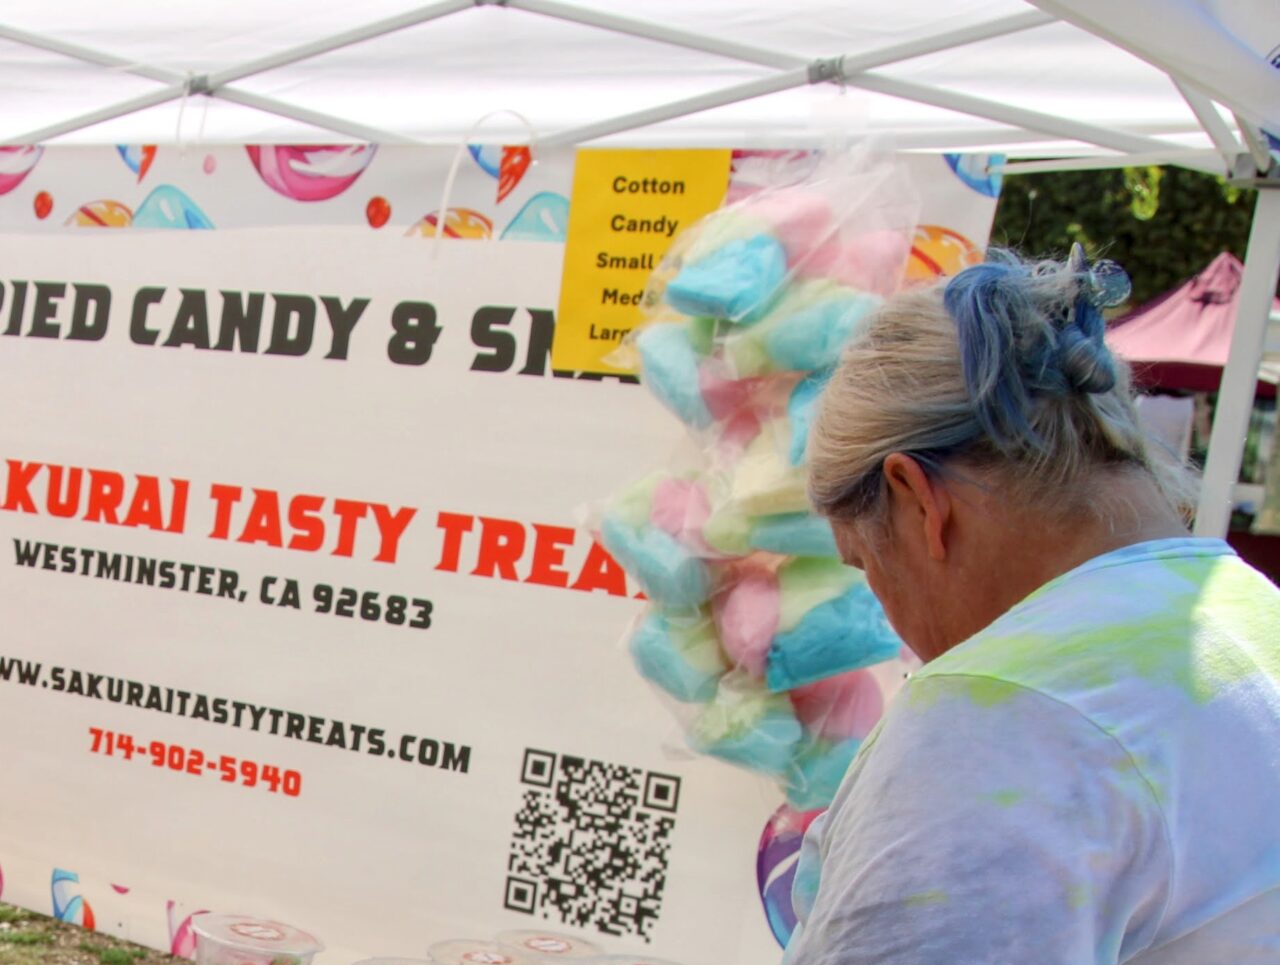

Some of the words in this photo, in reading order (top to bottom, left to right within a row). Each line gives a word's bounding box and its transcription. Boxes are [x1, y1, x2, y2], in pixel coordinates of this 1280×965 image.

[612, 176, 685, 194] Cotton
[610, 214, 678, 237] Candy
[596, 252, 653, 270] Small
[128, 285, 372, 361] CANDY
[386, 300, 444, 367] &
[209, 482, 418, 564] TASTY
[433, 510, 649, 601] TREA
[13, 538, 247, 602] WESTMINSTER,
[258, 575, 301, 611] CA
[313, 583, 434, 631] 92683
[88, 727, 302, 797] 714-902-5940
